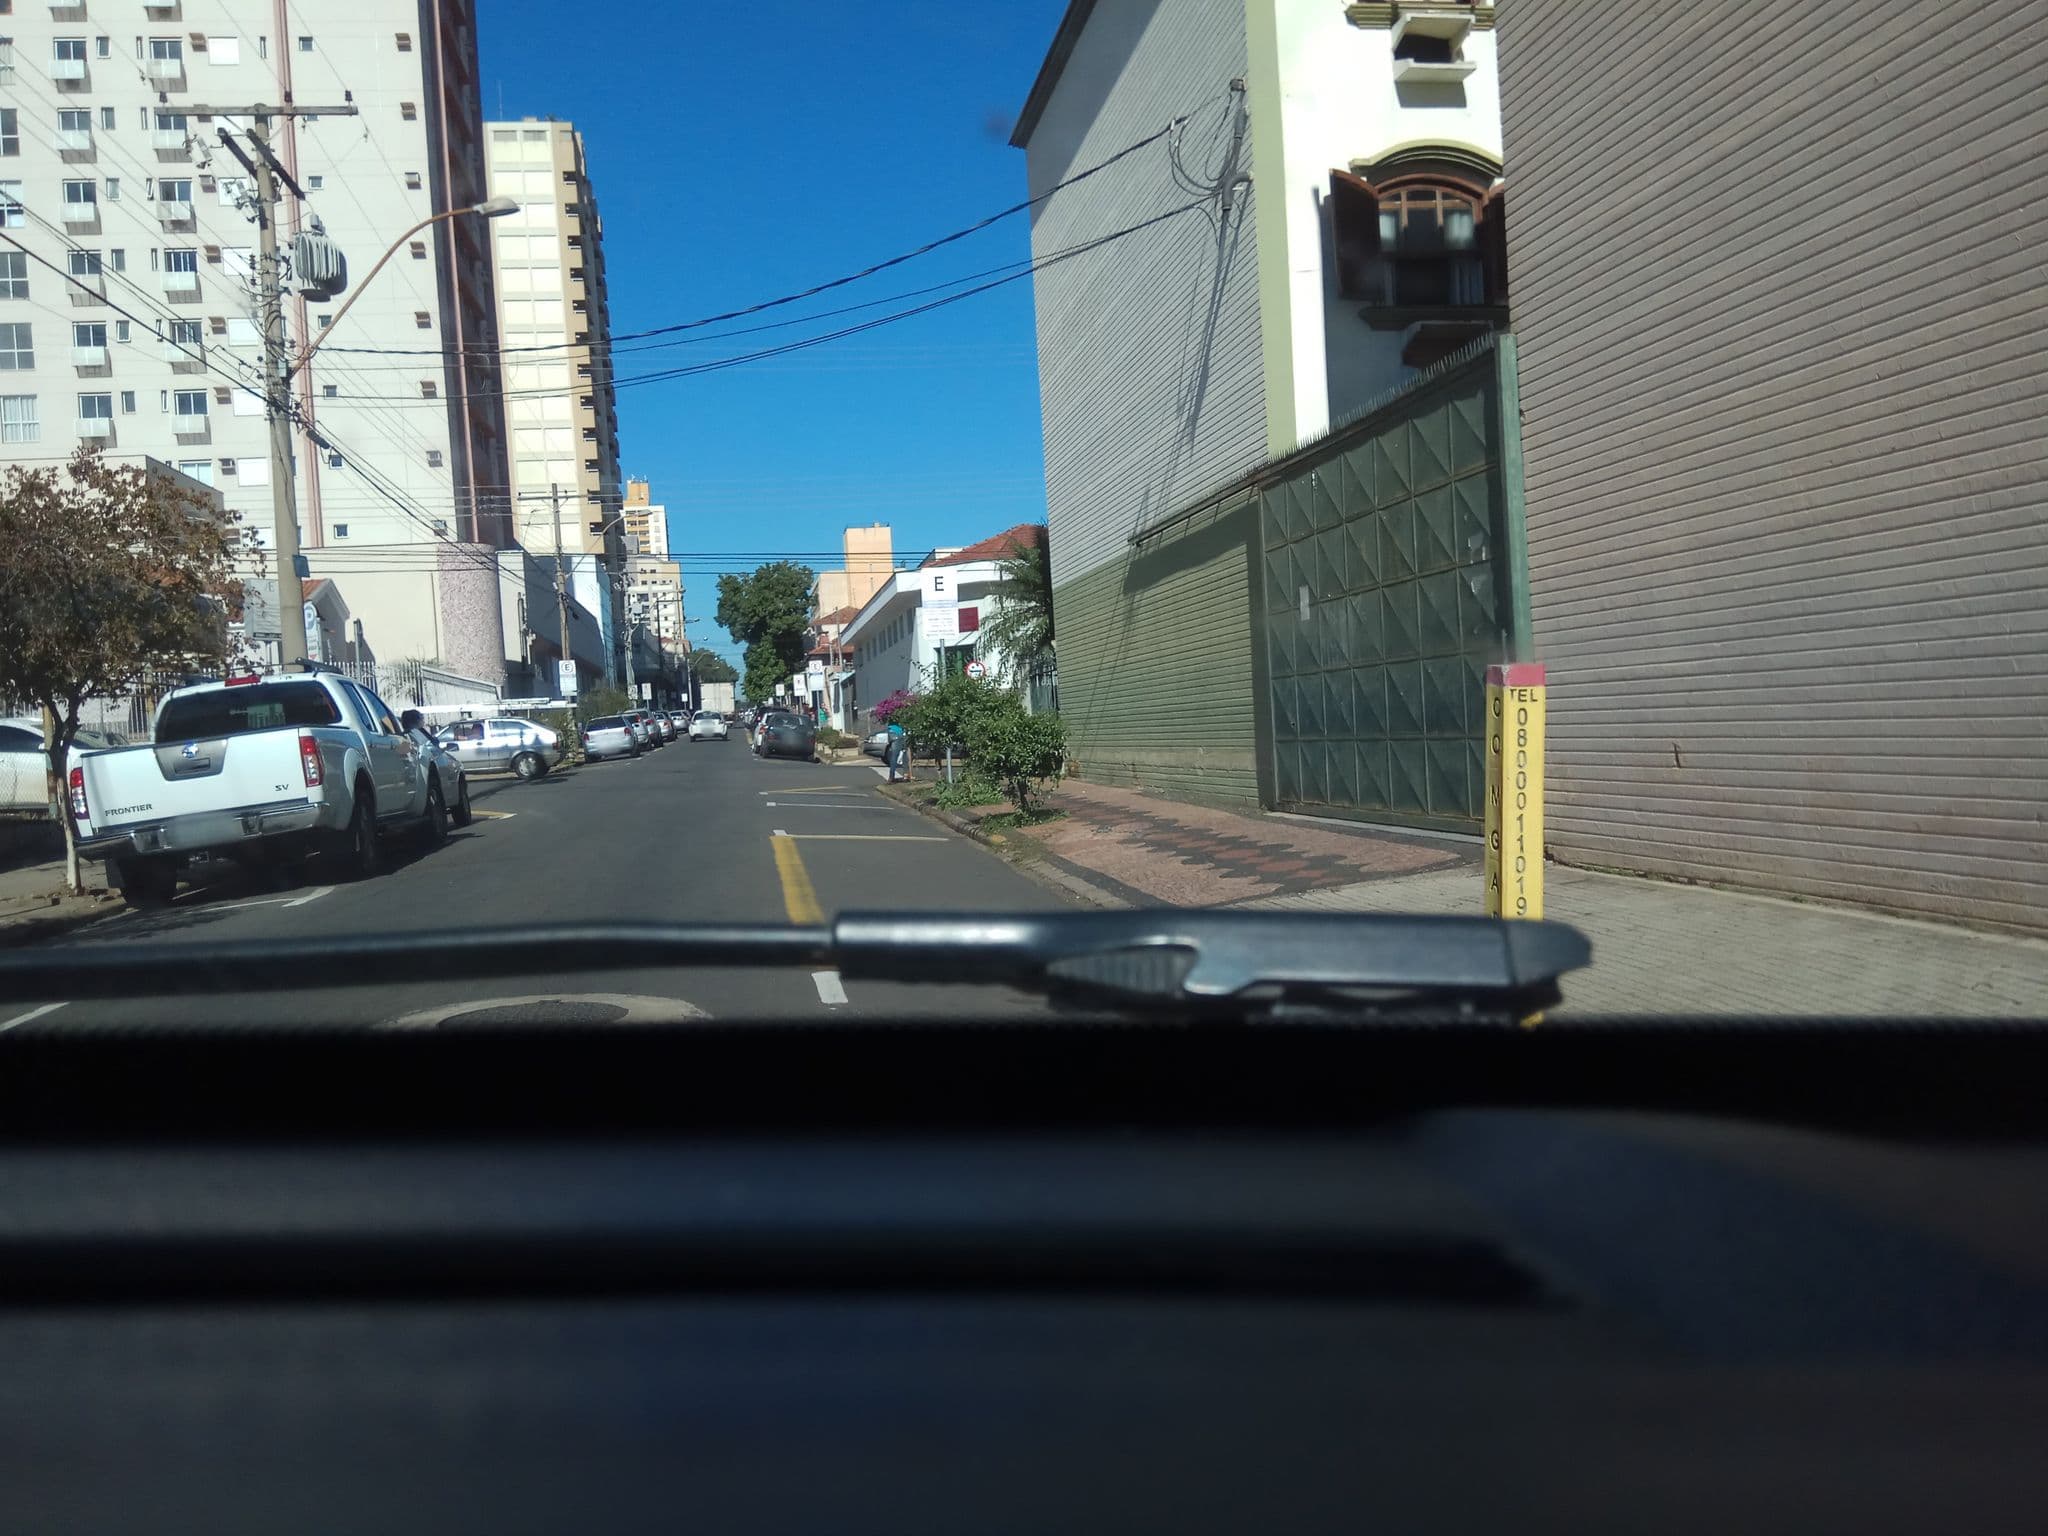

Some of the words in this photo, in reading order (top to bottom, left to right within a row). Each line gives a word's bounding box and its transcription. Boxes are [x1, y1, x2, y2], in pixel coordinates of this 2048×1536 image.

[934, 575, 945, 592] E
[1509, 688, 1538, 703] TEL
[274, 783, 290, 792] SV
[104, 803, 153, 817] FRONTIER
